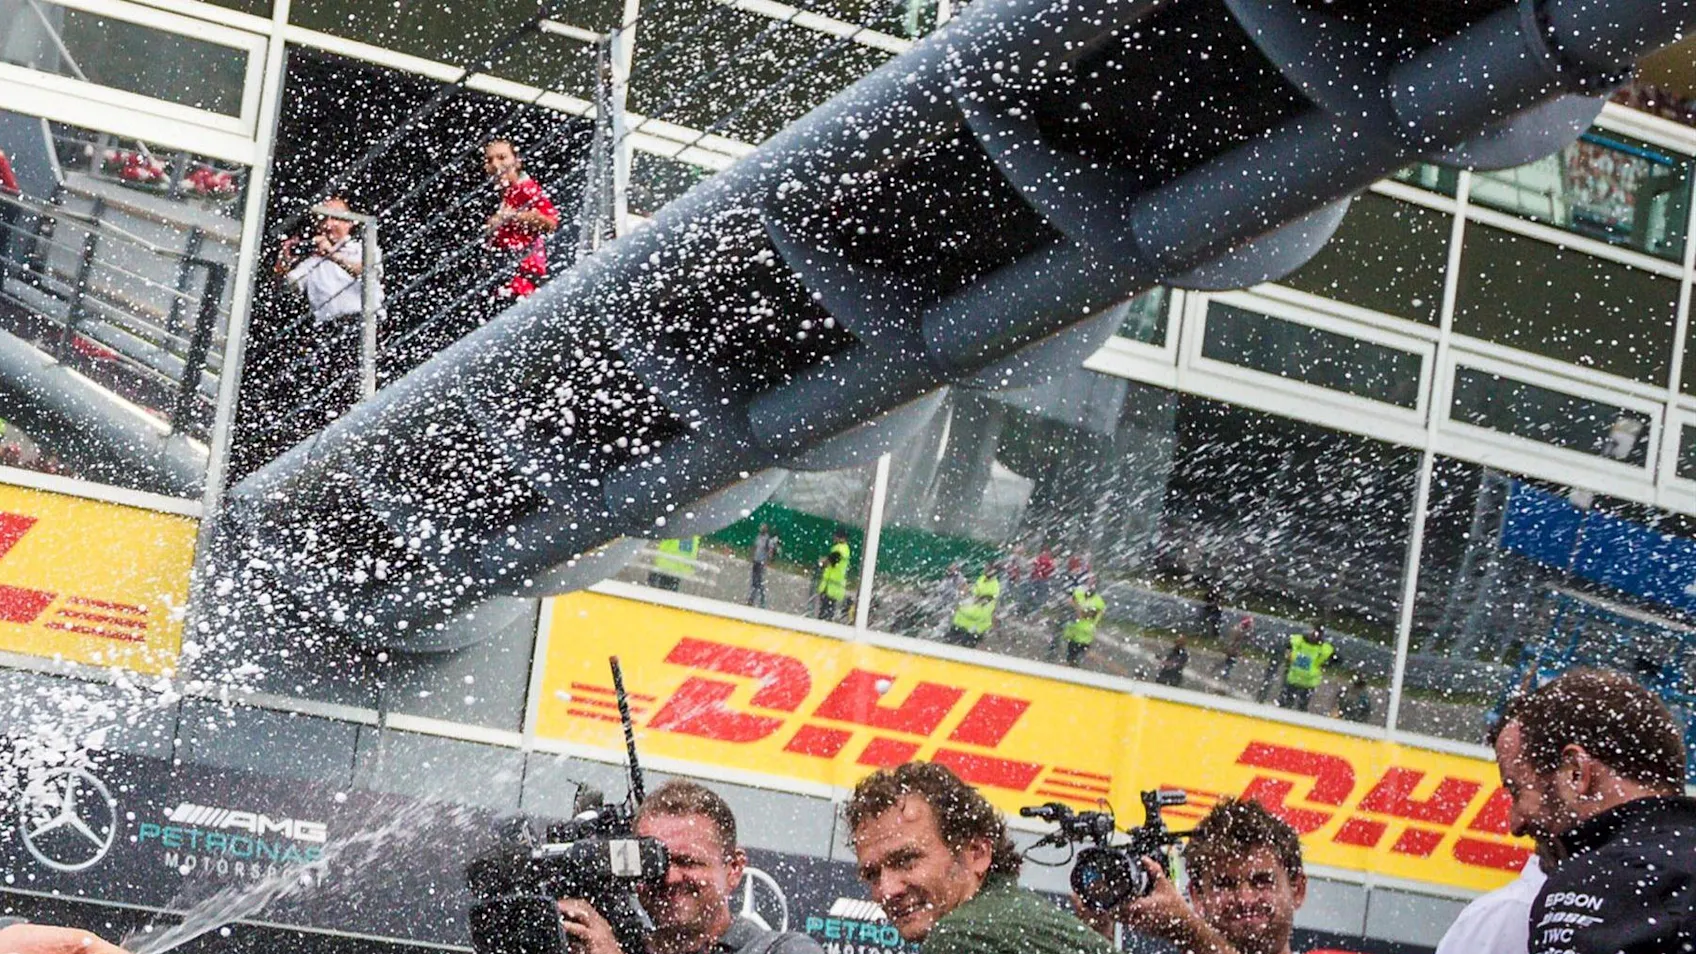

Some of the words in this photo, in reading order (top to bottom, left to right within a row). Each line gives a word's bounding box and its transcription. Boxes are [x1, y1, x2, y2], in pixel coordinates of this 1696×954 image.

[646, 636, 1044, 791] DHL
[219, 810, 329, 843] AMG
[617, 845, 632, 876] 1
[1544, 891, 1604, 911] EPSON
[1542, 928, 1574, 945] IWC
